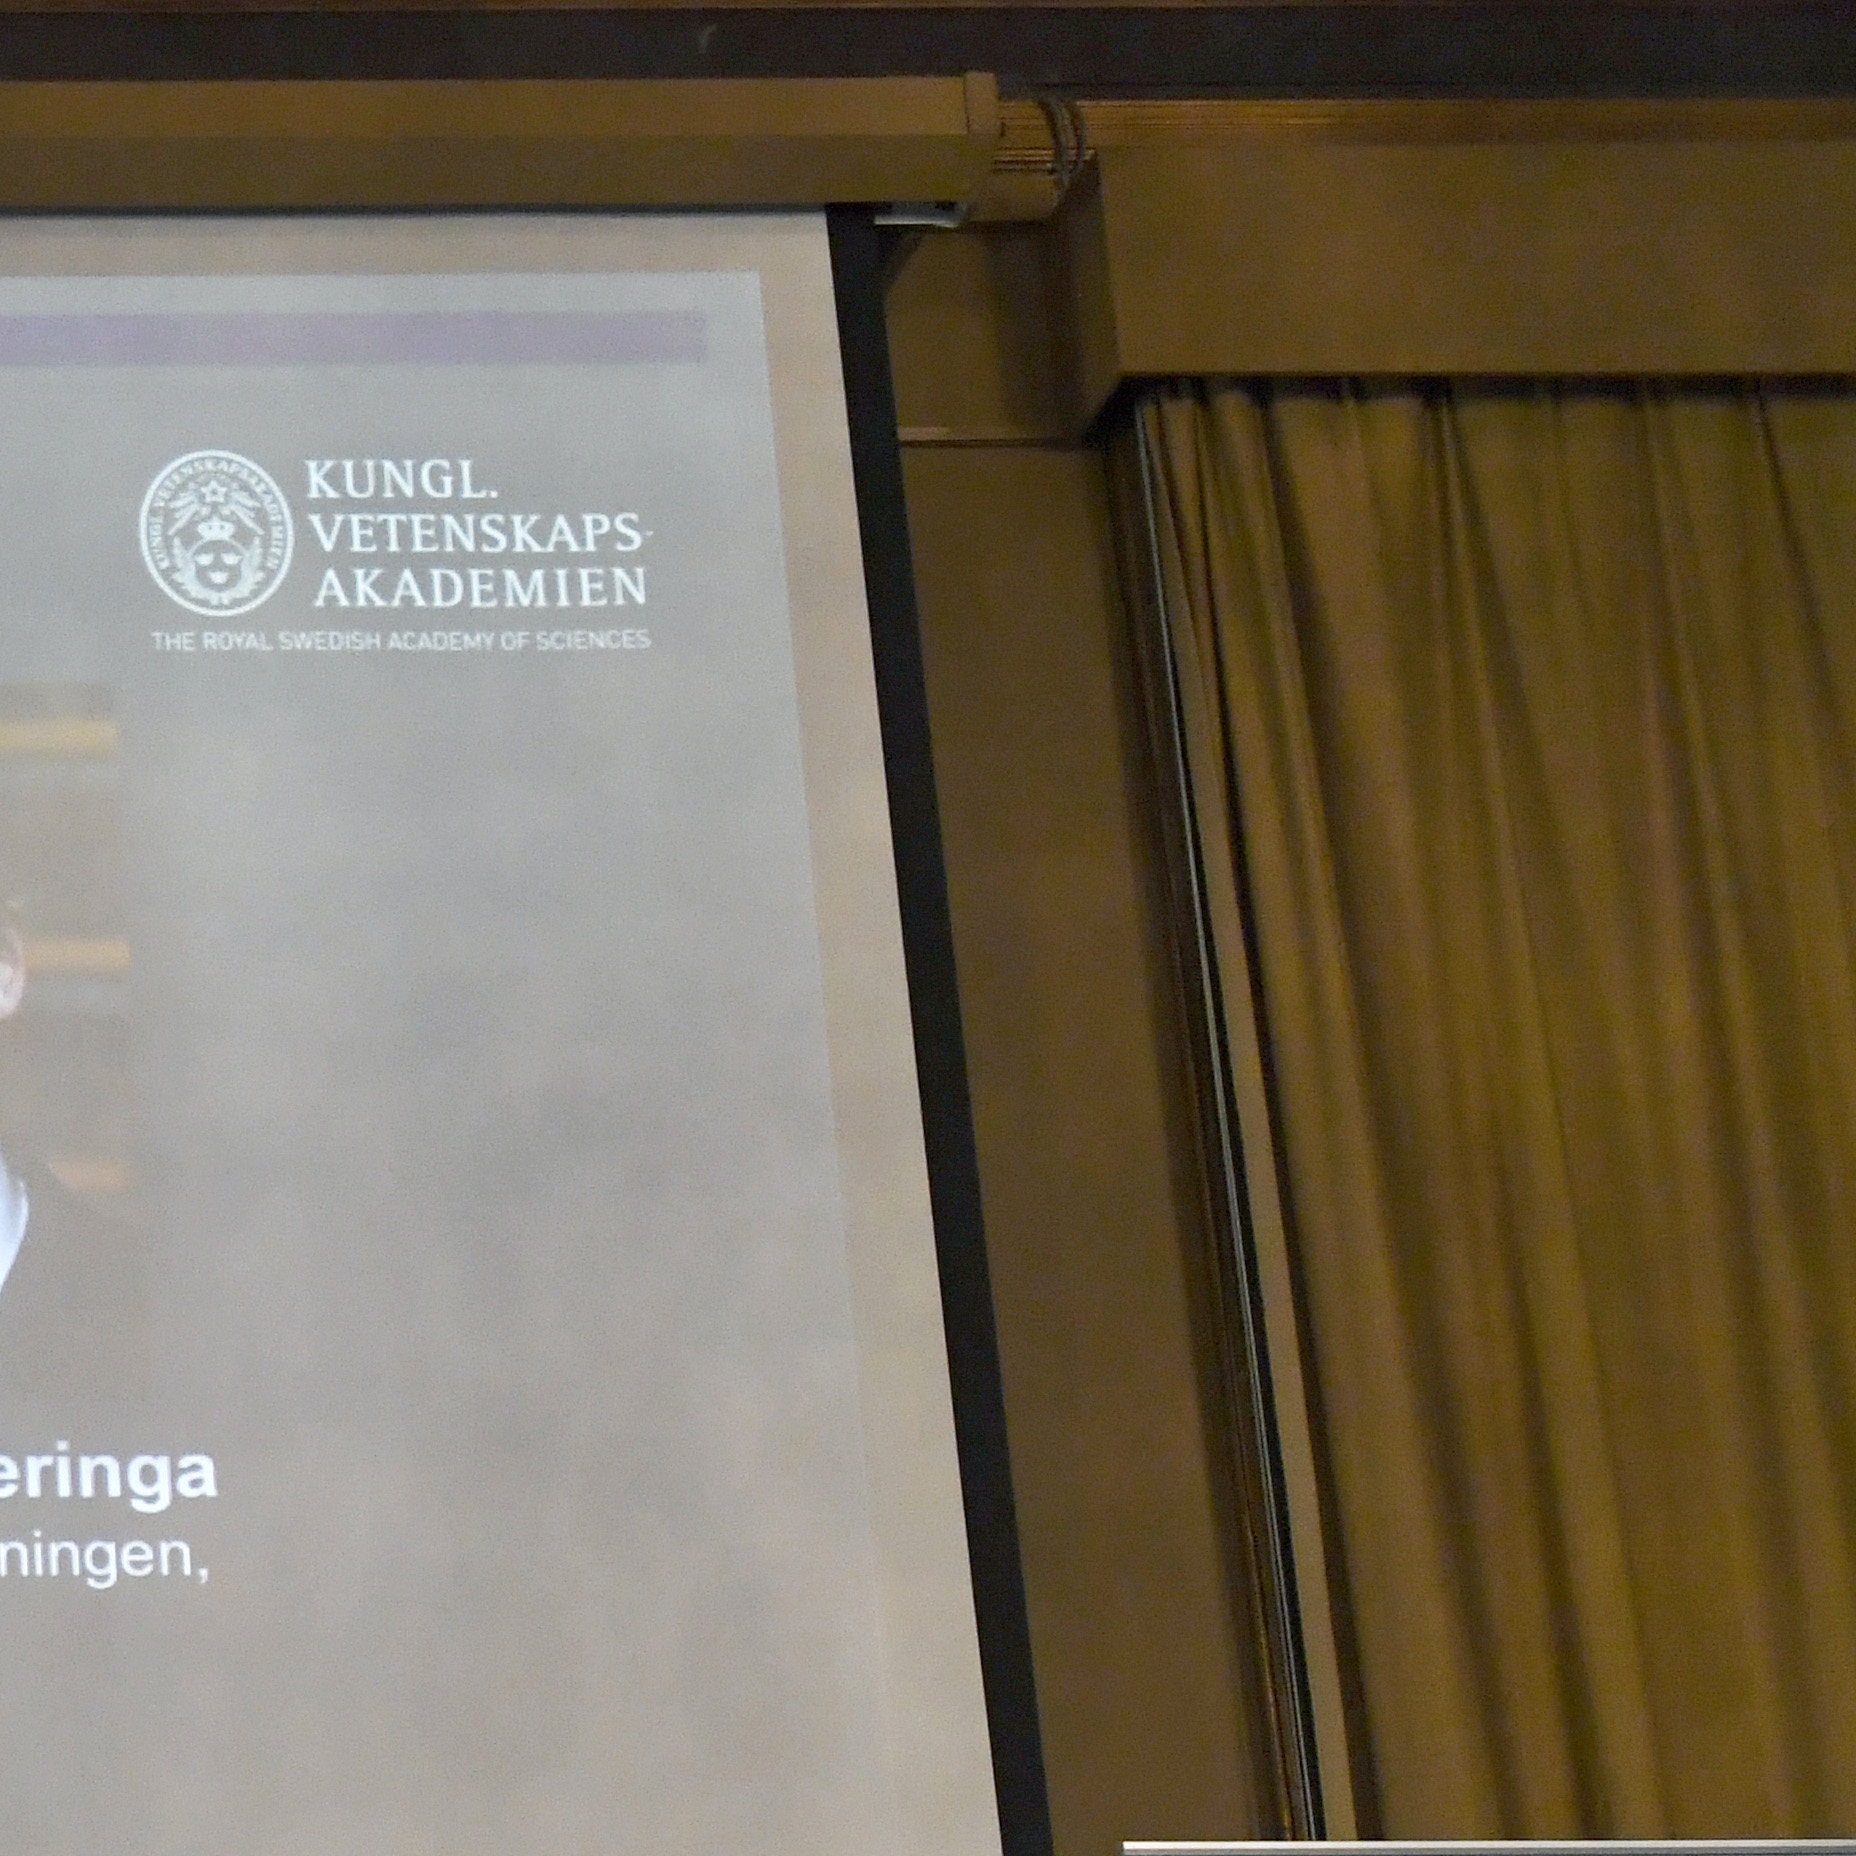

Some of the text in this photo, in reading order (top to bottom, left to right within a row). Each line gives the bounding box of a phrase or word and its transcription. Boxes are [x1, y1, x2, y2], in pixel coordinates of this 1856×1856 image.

[305, 459, 498, 499] KUNGL.
[308, 512, 654, 553] VETENSKAPS-
[314, 567, 646, 608] AKADEMIEN
[152, 629, 651, 652] THE ROYAL SWEDISH ACADEMY OF SCIENCES
